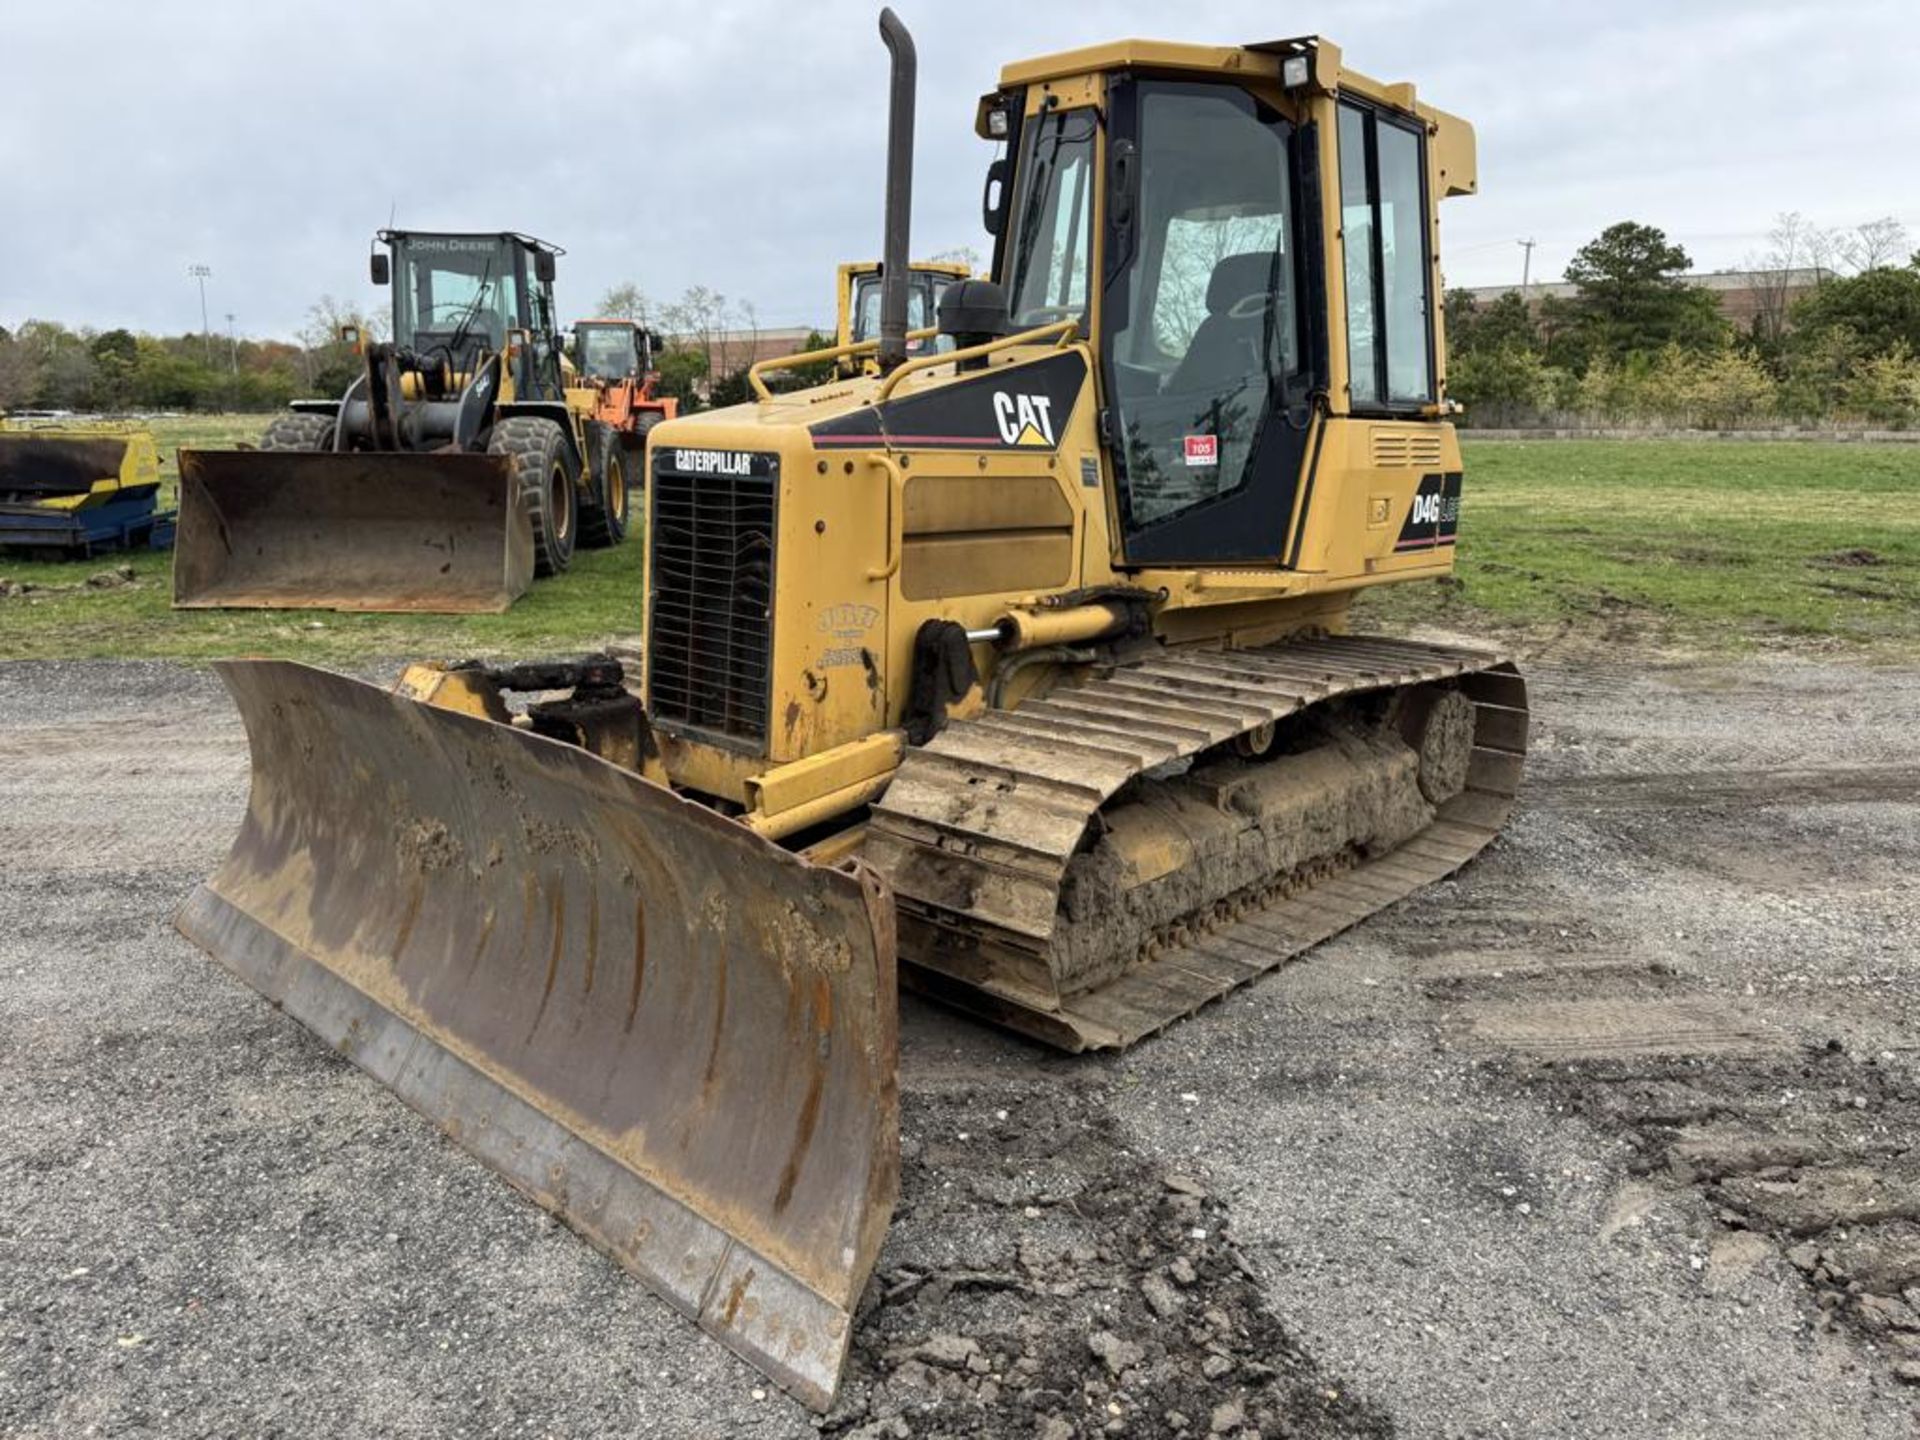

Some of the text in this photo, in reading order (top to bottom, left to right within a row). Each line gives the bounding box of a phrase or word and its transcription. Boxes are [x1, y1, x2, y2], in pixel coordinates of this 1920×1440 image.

[408, 239, 495, 251] JOHN DEERE
[993, 391, 1056, 446] CAT
[675, 449, 751, 475] CATERPILLAR
[1413, 493, 1440, 524] D4G
